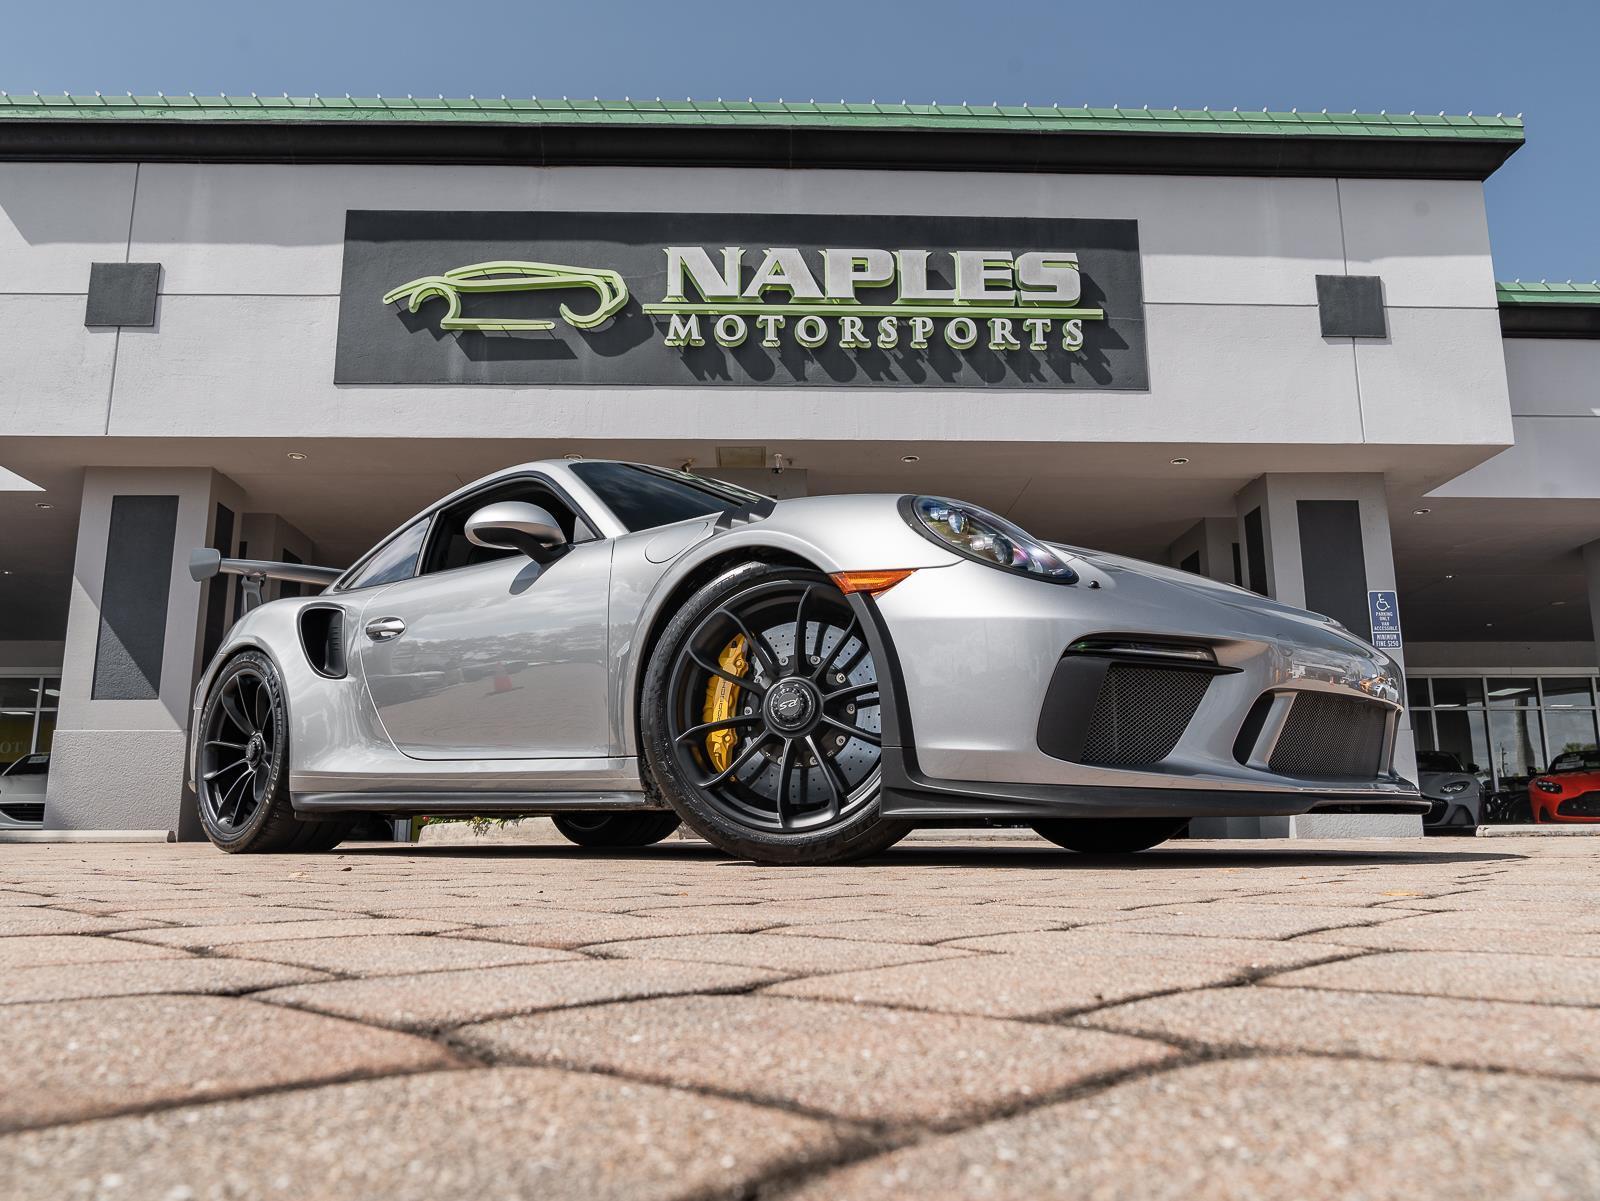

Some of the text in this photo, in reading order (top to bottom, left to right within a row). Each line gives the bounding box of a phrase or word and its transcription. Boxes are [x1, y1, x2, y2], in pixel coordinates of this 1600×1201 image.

[662, 246, 1082, 307] NAPLES
[664, 314, 1084, 351] MOTORSPORTS
[716, 681, 726, 722] PORSCH
[779, 698, 799, 711] RS
